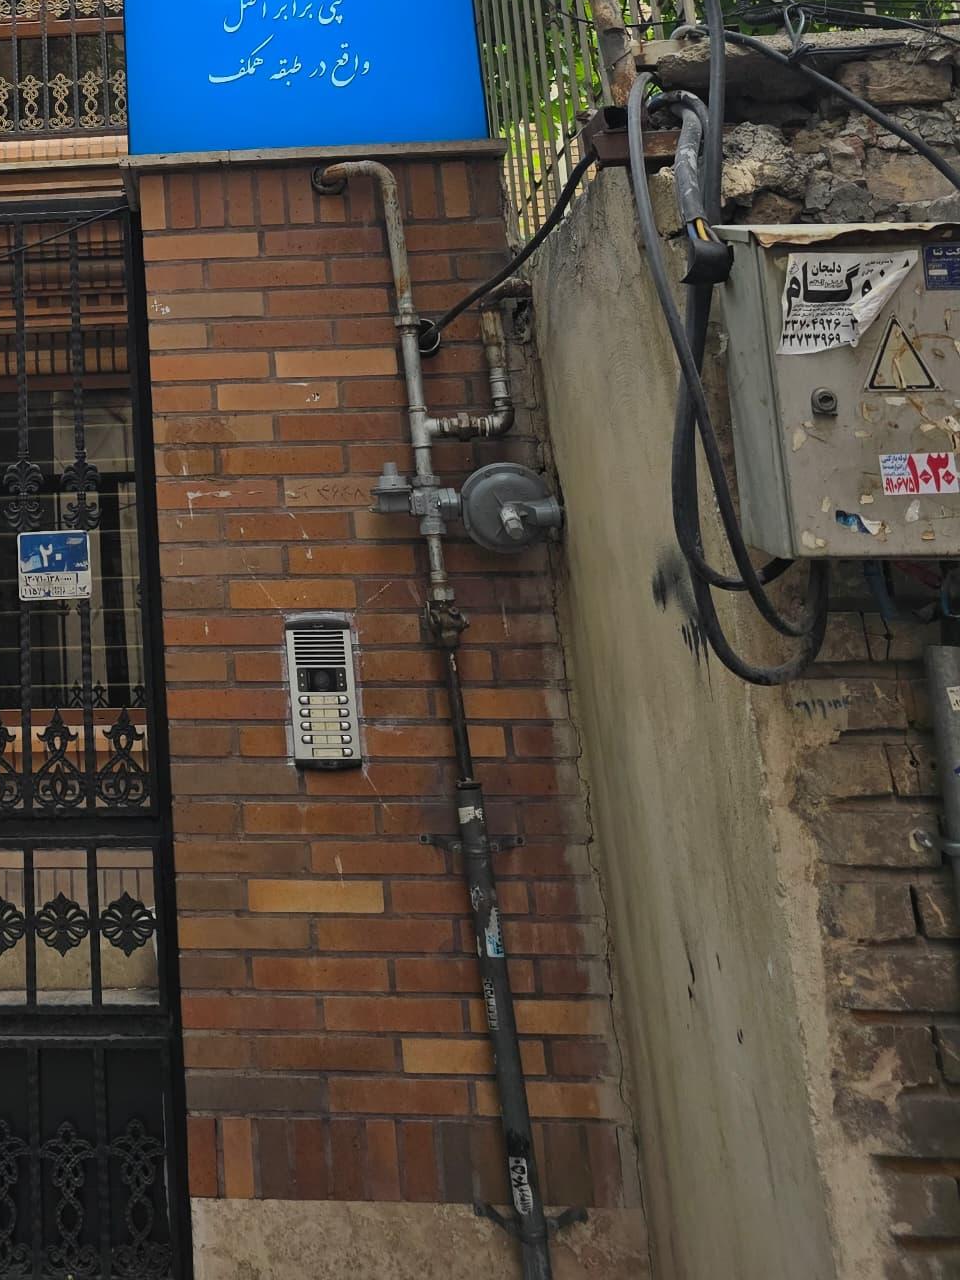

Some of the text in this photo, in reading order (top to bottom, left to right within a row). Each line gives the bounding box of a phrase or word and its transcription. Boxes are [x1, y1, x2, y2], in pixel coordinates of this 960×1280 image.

[273, 0, 313, 21] برابر
[208, 34, 370, 87] واقع در طبقه همکف
[811, 261, 842, 277] دلیجان
